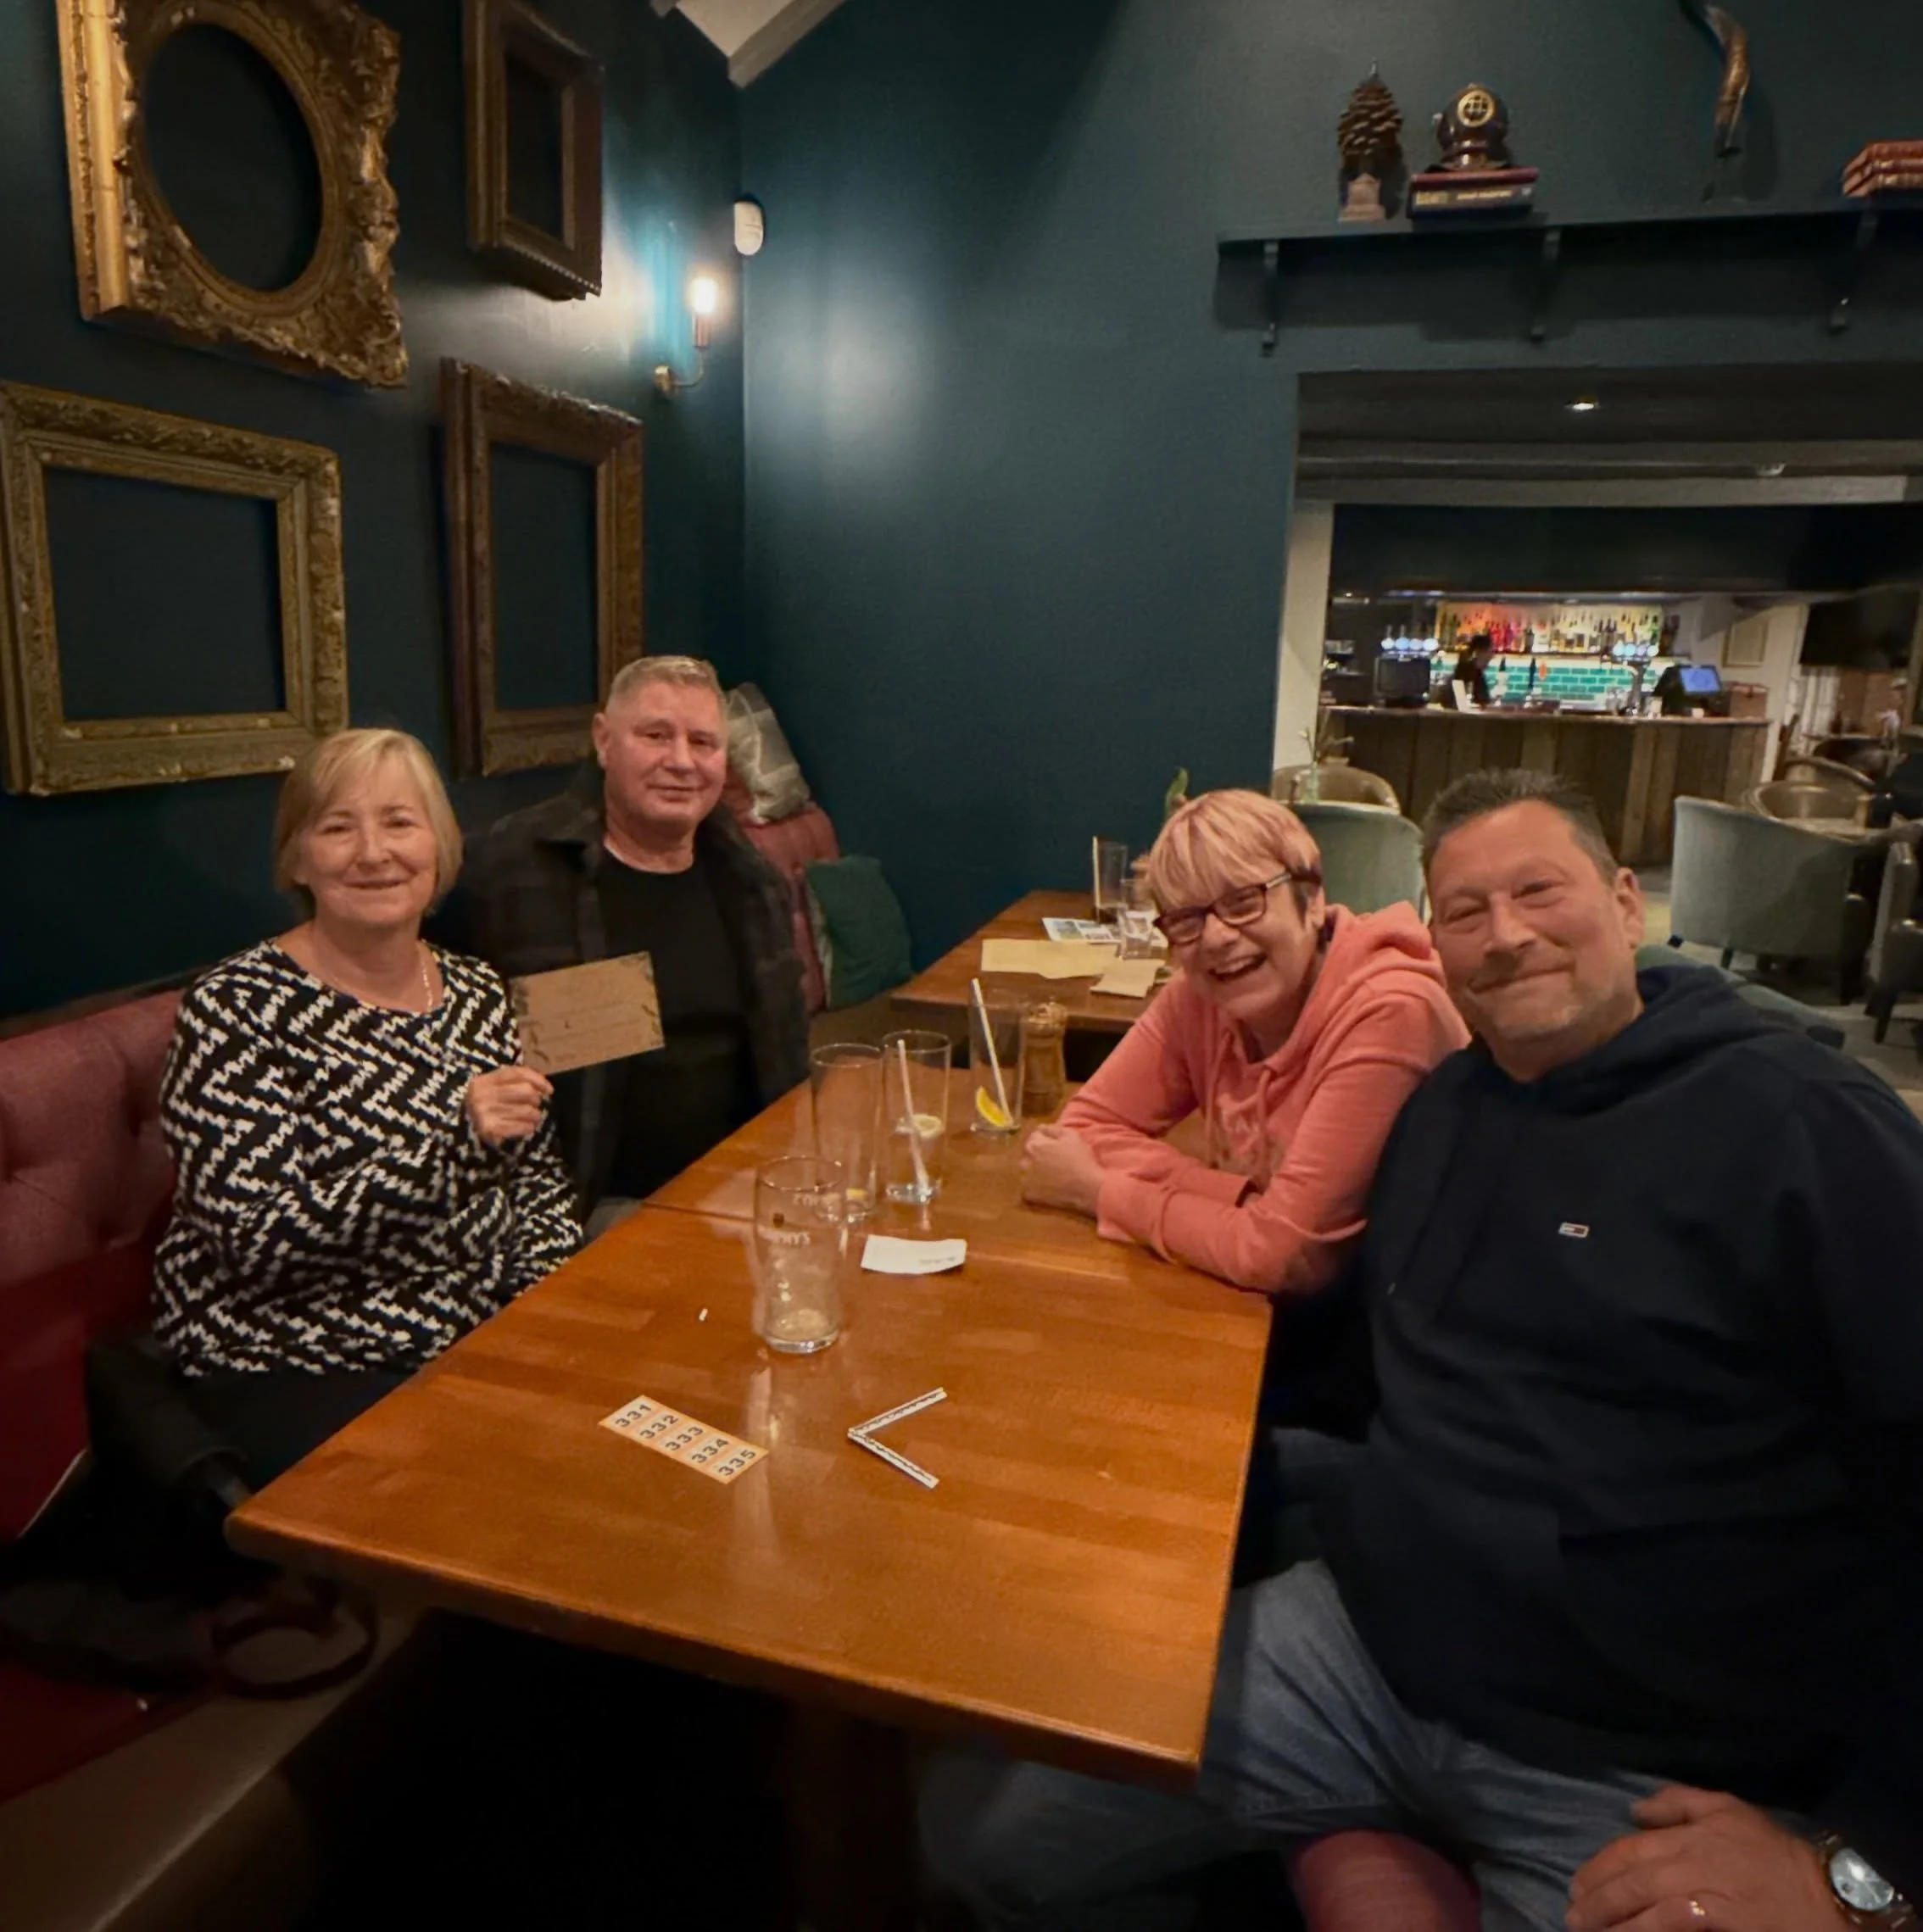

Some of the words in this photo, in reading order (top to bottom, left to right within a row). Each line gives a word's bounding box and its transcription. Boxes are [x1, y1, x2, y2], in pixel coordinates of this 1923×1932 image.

[615, 1404, 651, 1428] 331
[639, 1415, 679, 1439] 332
[665, 1427, 704, 1450] 333
[692, 1439, 729, 1463] 334
[718, 1450, 756, 1476] 335
